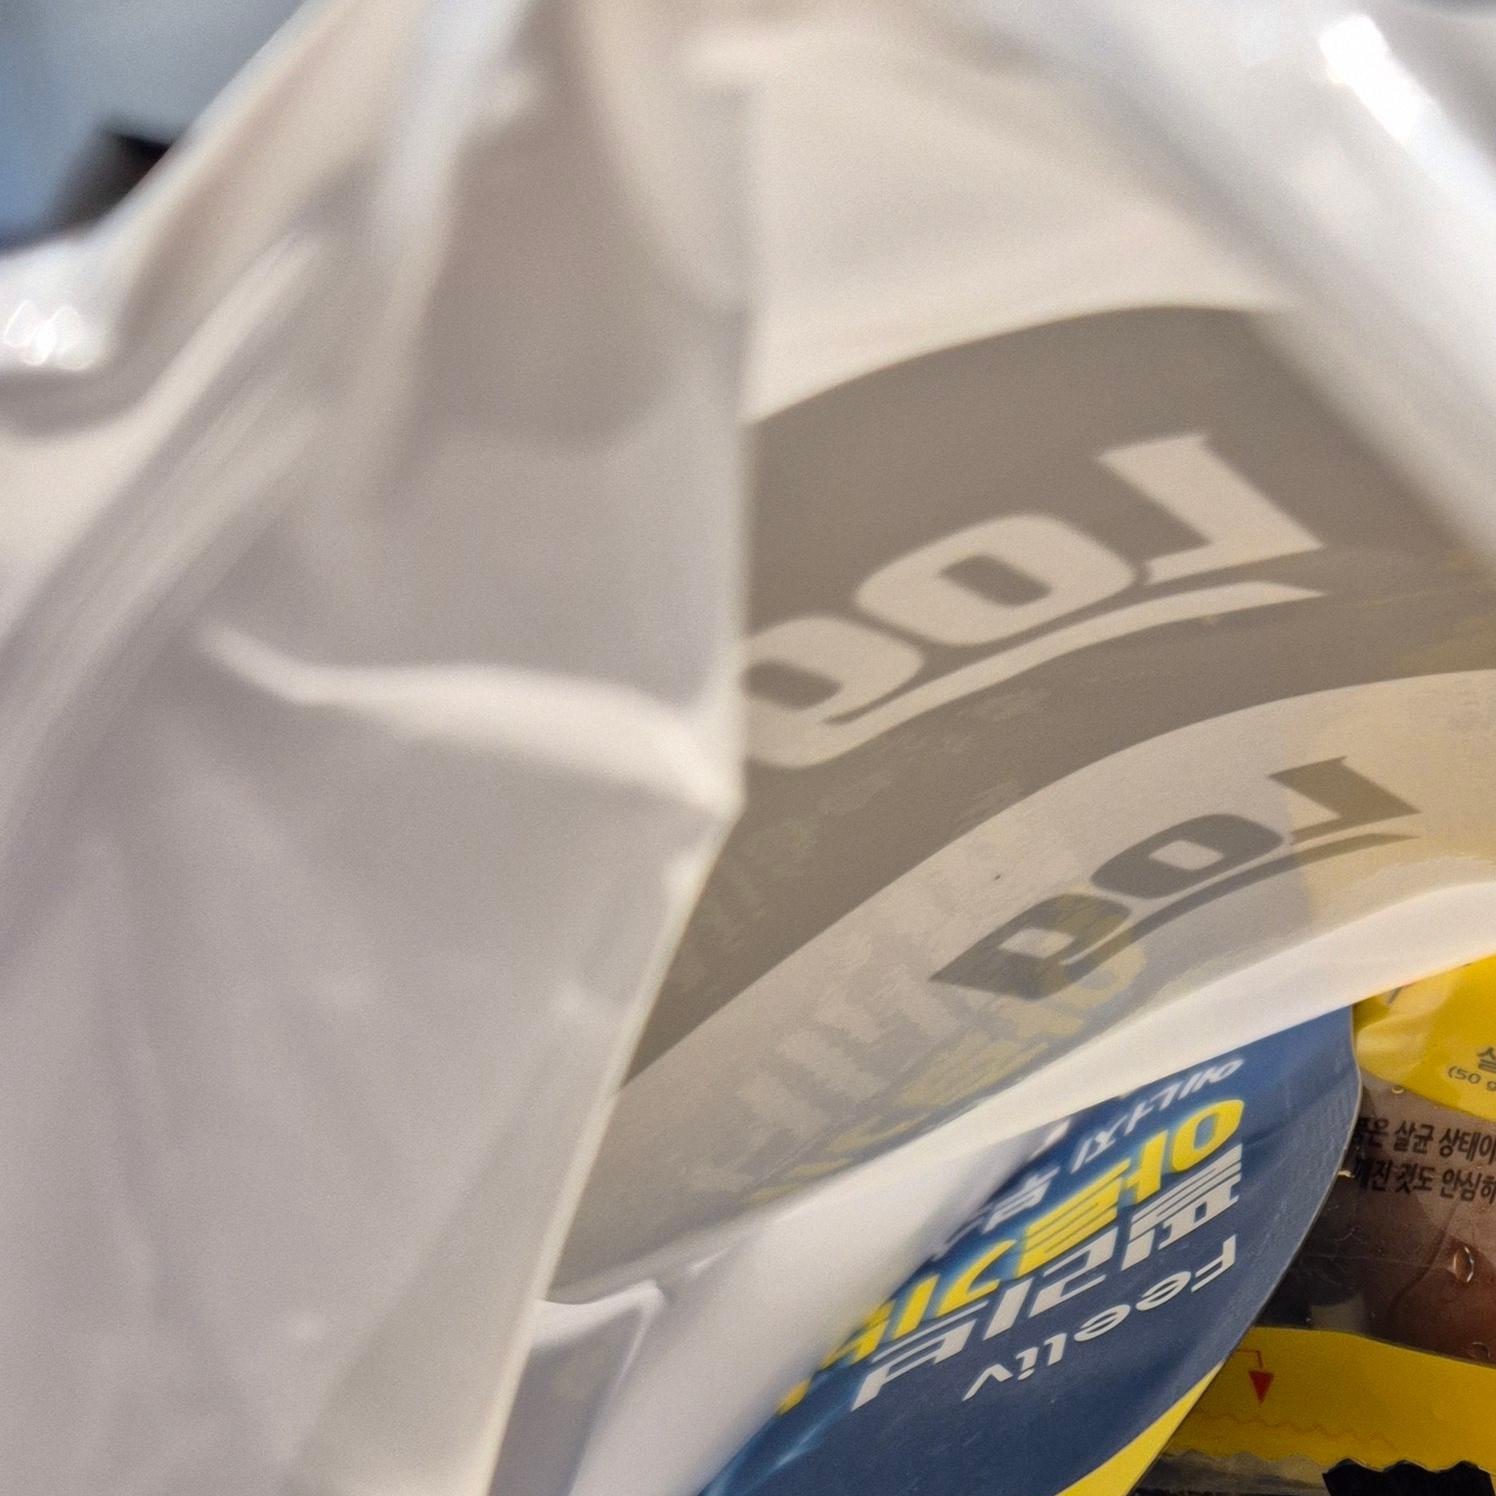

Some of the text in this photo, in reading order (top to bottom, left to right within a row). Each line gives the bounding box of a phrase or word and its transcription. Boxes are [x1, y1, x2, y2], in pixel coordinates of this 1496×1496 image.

[1447, 1065, 1482, 1085] (50
[1070, 1057, 1245, 1175] 에너지
[1394, 1120, 1435, 1154] 살균
[1395, 1161, 1436, 1195] 것도
[850, 1143, 1243, 1412] 필리브
[962, 1234, 1237, 1402] Feeliv
